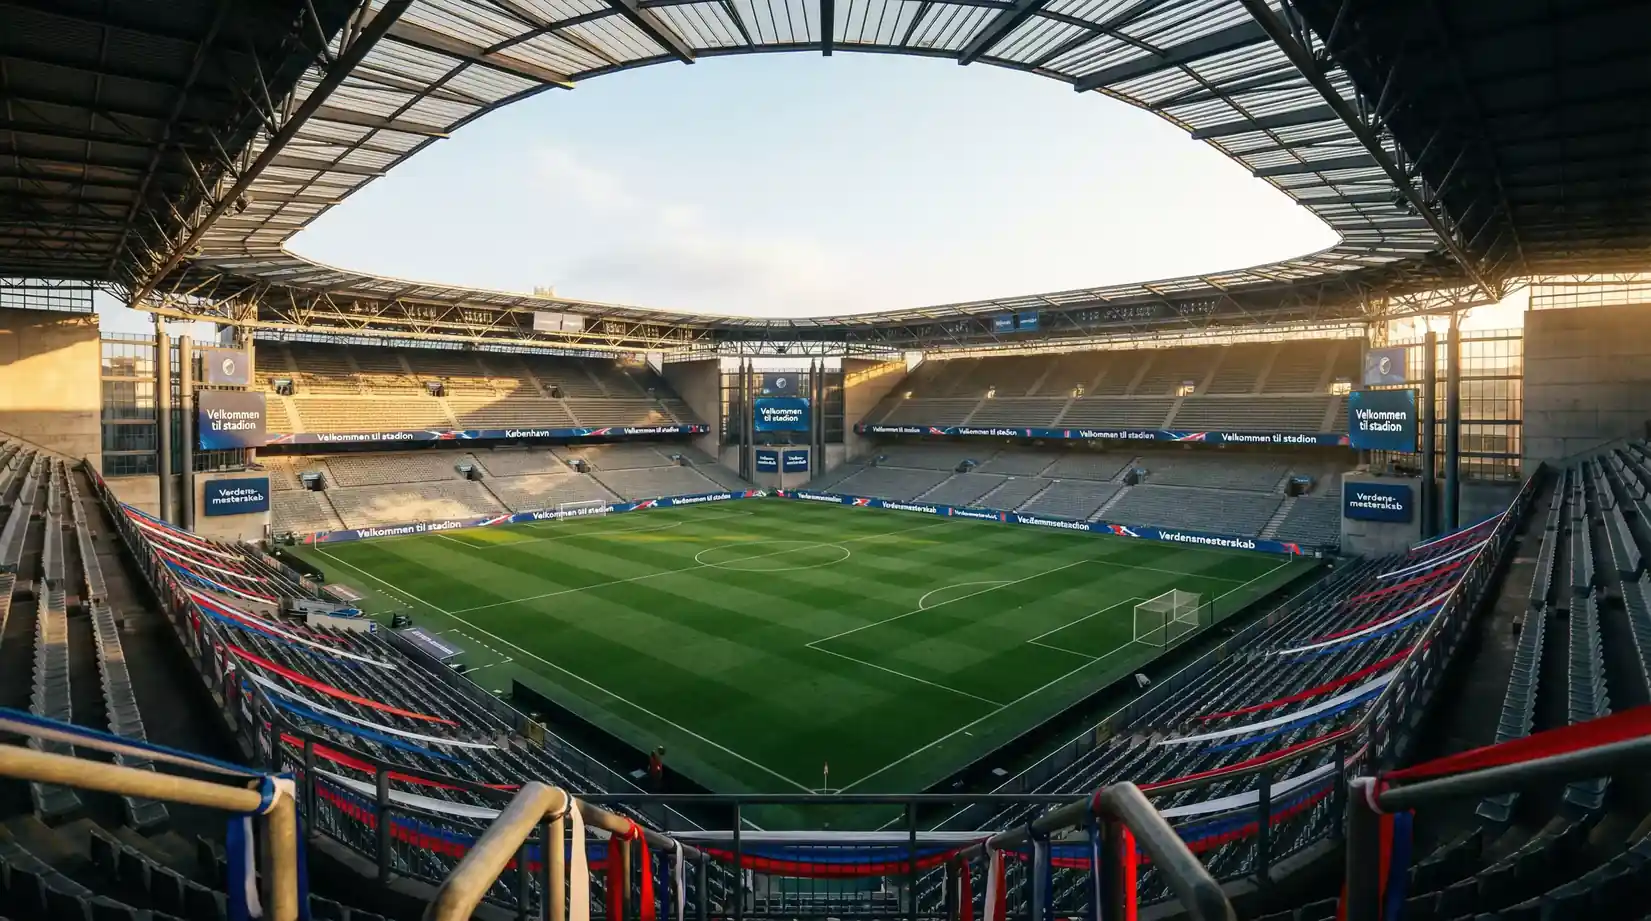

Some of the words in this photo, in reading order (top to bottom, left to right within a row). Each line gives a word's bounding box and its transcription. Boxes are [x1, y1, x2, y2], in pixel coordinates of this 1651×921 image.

[207, 409, 260, 420] Velkommen
[760, 407, 802, 415] Velkommen
[1356, 409, 1406, 420] Velkommen
[212, 420, 221, 431] til
[223, 420, 256, 431] stadion
[1359, 420, 1368, 431] til
[1369, 421, 1402, 431] stadion
[317, 433, 370, 441] Velkommen
[371, 432, 380, 440] til
[382, 431, 413, 440] stadion
[505, 429, 549, 437] København
[1079, 430, 1118, 438] Velkommen
[1119, 431, 1127, 439] til
[1128, 431, 1154, 439] stadion
[1221, 433, 1270, 442] Velkommen
[1272, 433, 1281, 442] til
[1283, 434, 1317, 443] stadion
[533, 510, 577, 519] Velkommen
[357, 525, 414, 538] Velkommen
[416, 523, 426, 532] til
[427, 520, 461, 531] stadion
[1158, 530, 1256, 549] Verdensmesterskab
